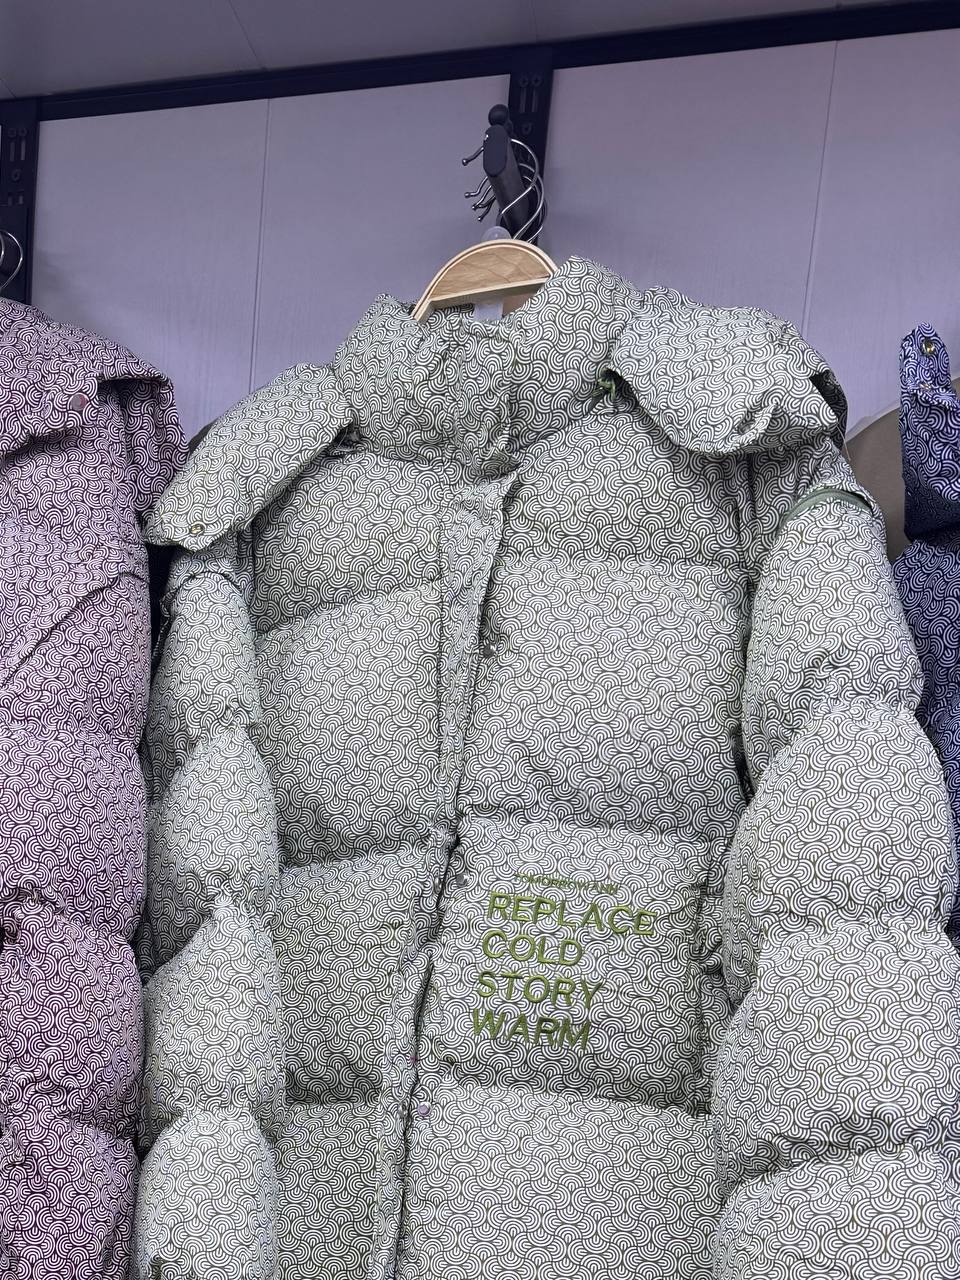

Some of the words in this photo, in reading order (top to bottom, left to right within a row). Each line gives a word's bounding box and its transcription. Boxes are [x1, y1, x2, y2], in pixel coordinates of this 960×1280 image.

[487, 892, 657, 936] REPLACE
[481, 930, 583, 966] COLD
[476, 970, 606, 1009] STORY
[471, 1008, 592, 1050] WARM
